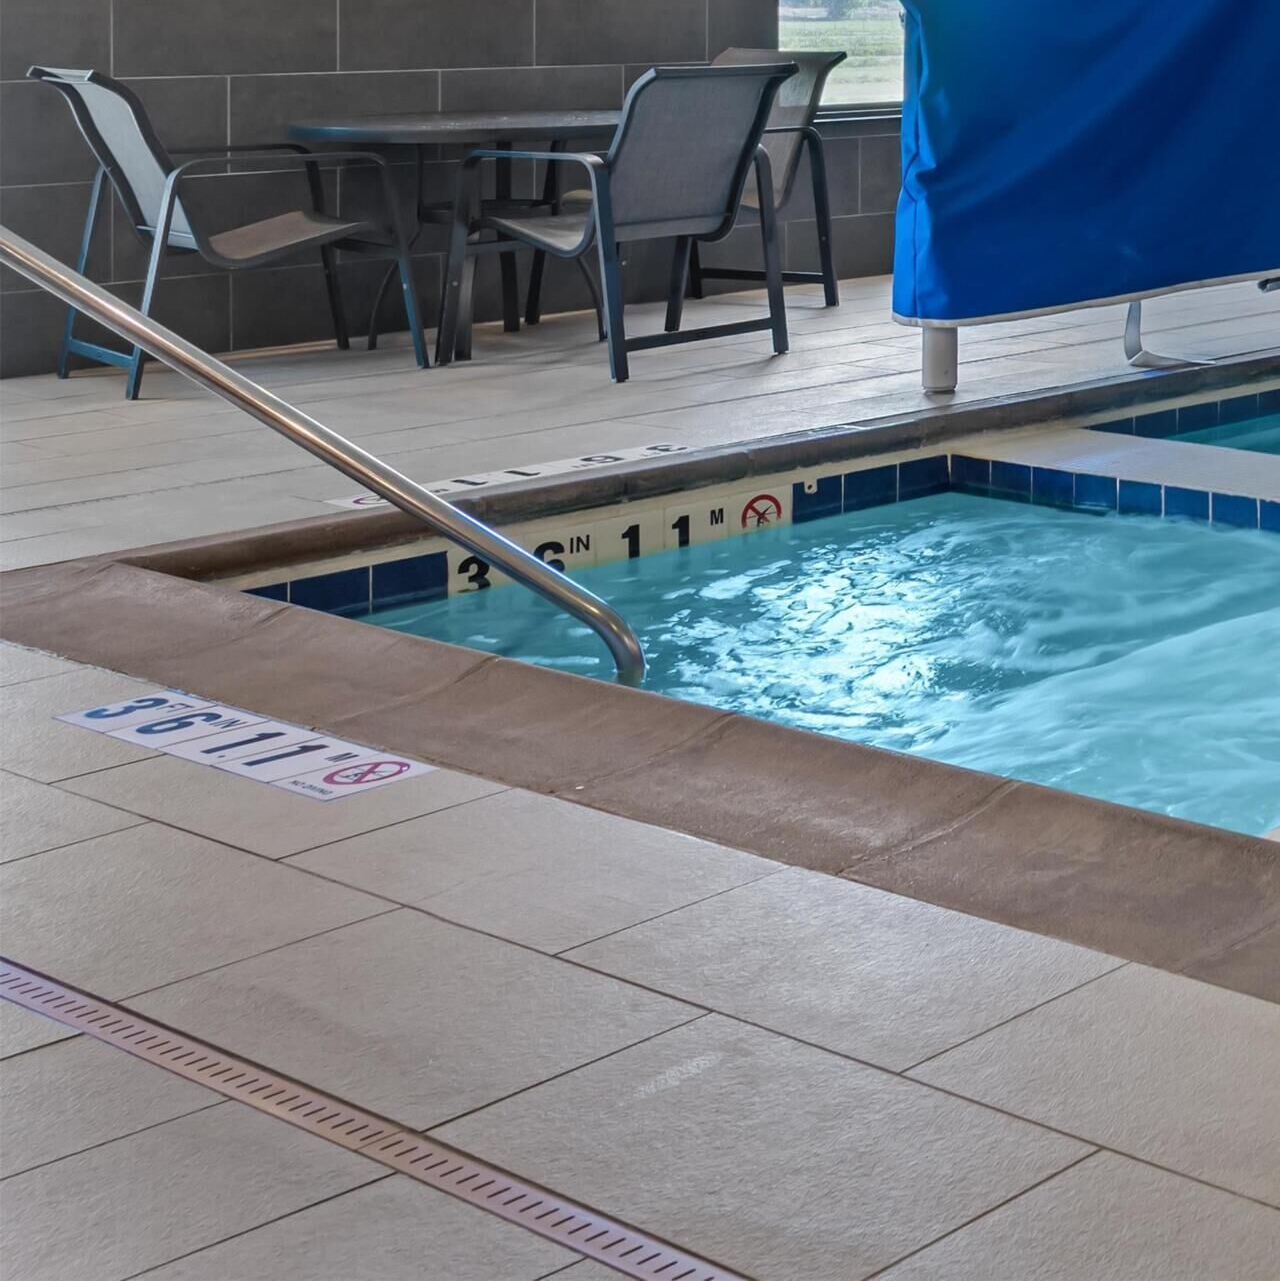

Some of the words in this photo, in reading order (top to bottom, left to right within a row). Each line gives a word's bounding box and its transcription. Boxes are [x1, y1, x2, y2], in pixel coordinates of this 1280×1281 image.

[457, 555, 492, 593] 3
[568, 533, 591, 555] IN
[709, 507, 725, 526] M
[83, 697, 170, 719] 3
[135, 711, 224, 735] 6
